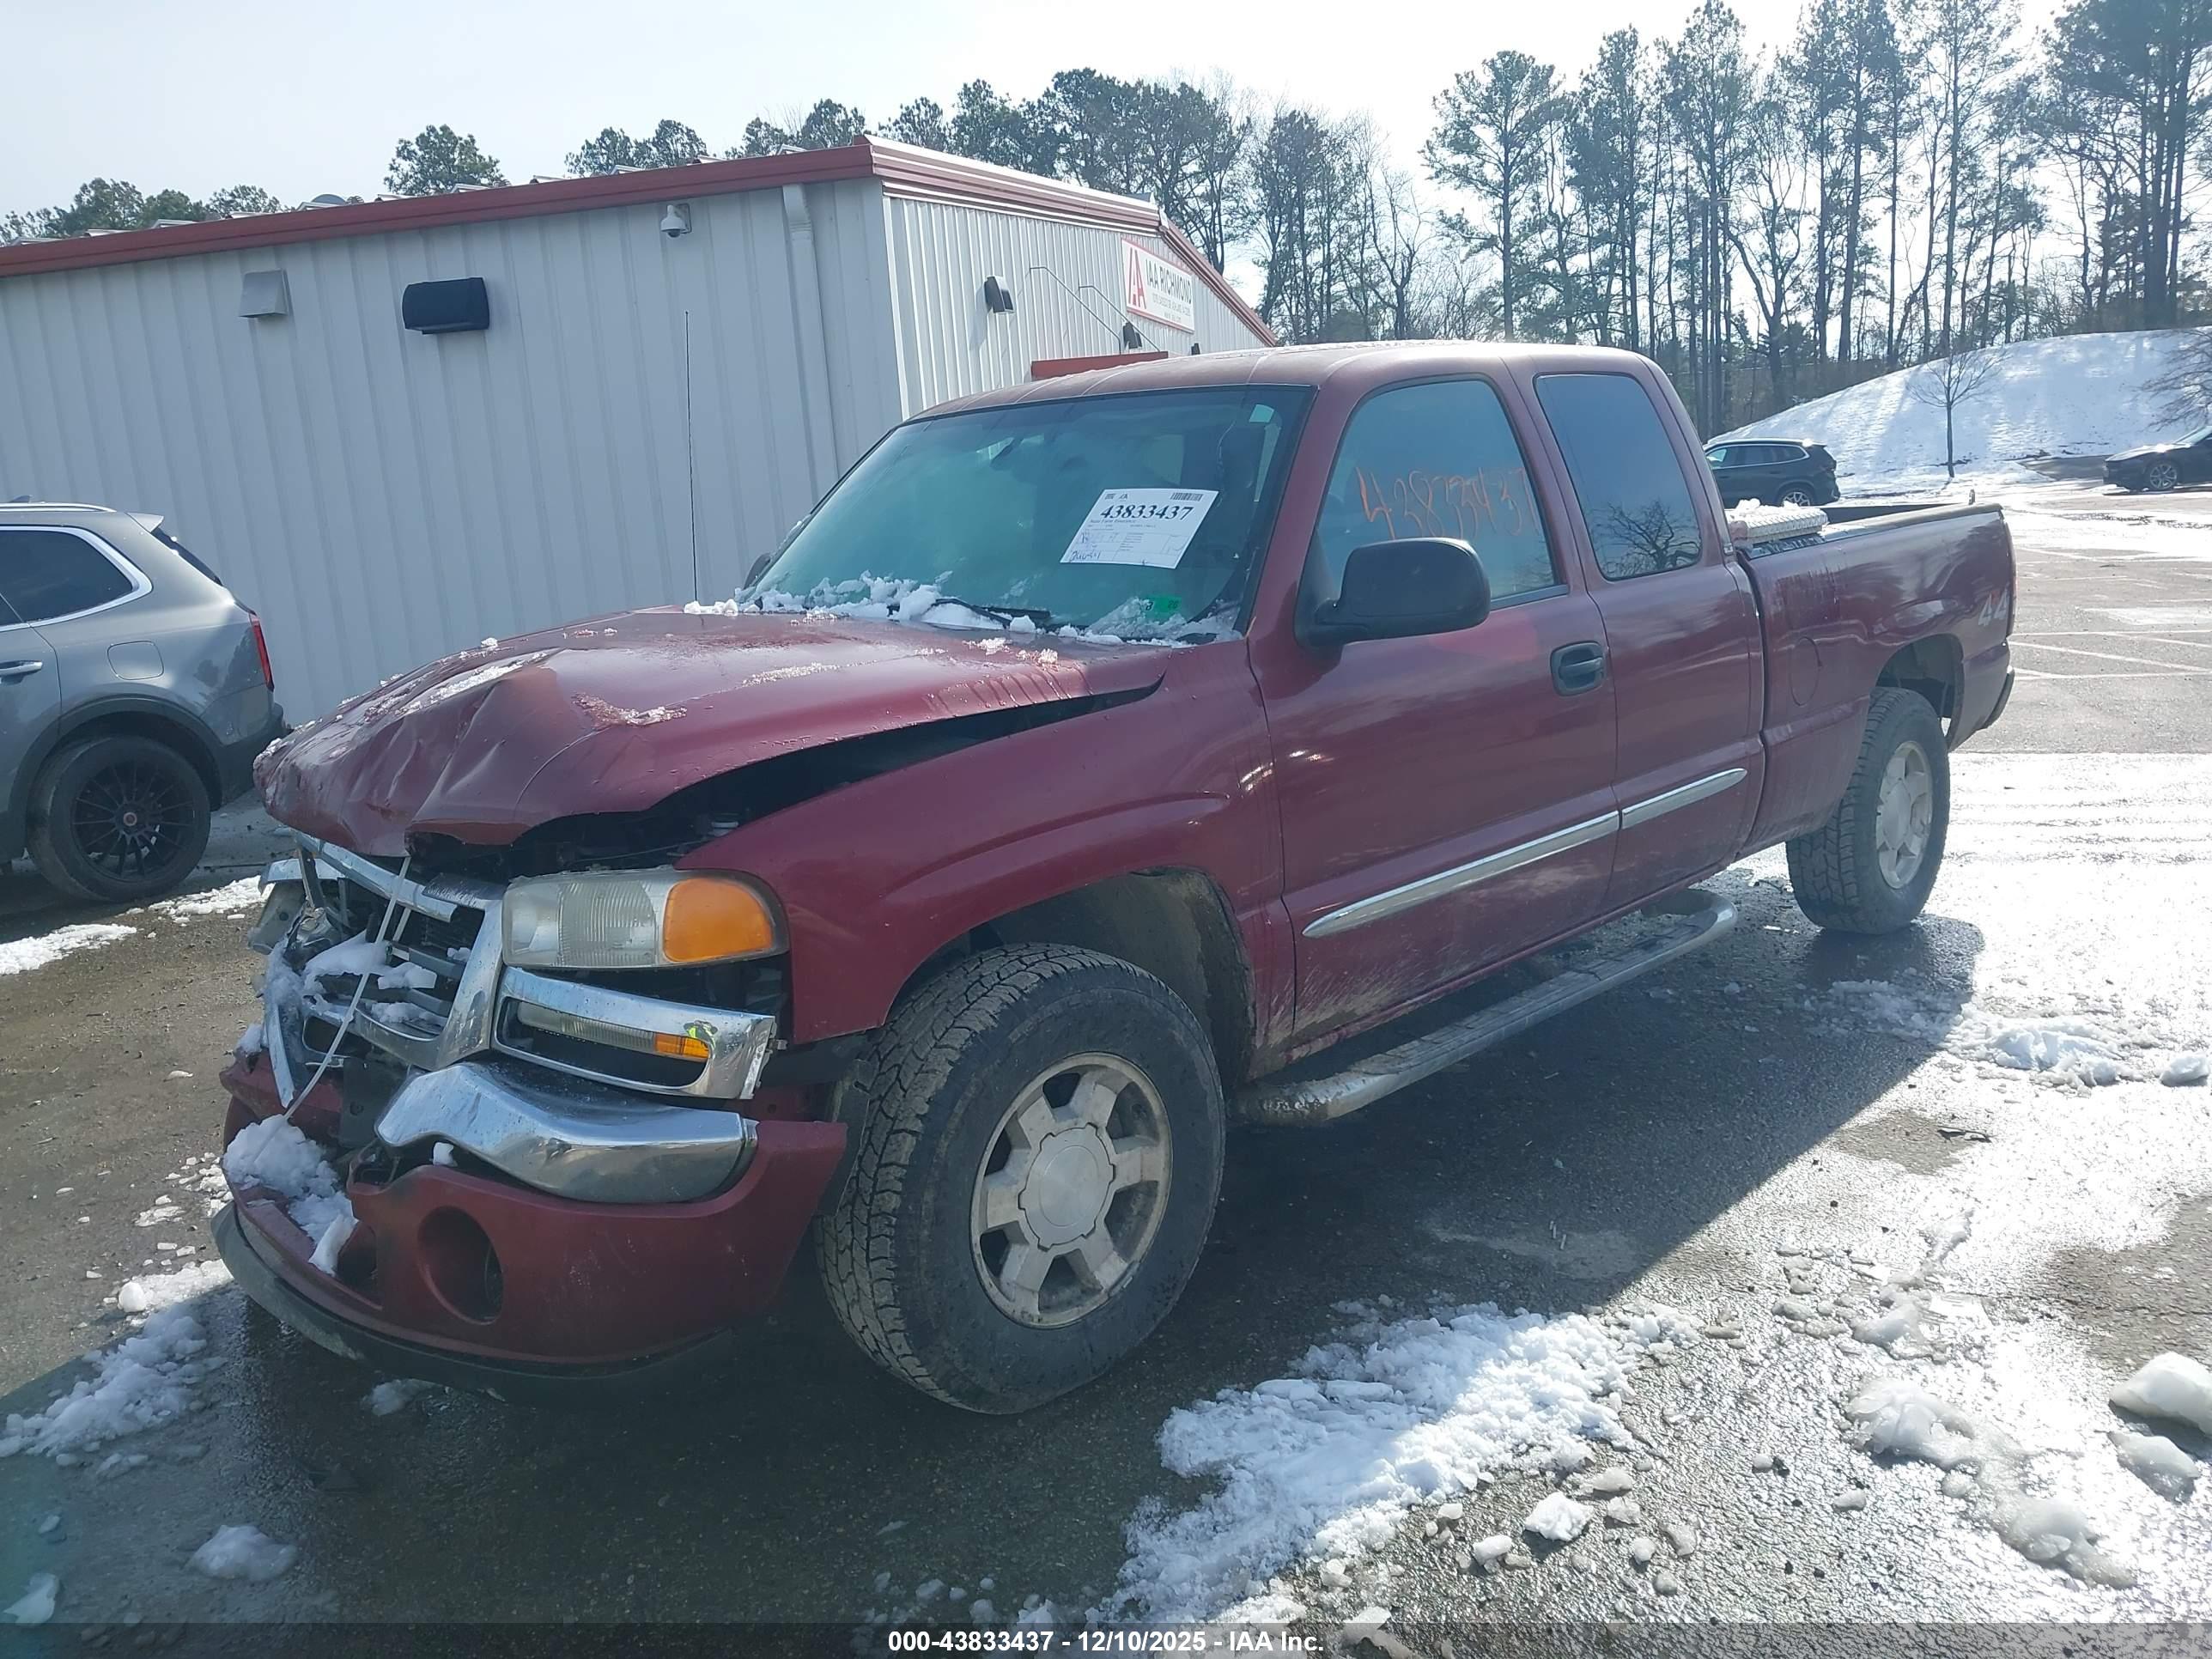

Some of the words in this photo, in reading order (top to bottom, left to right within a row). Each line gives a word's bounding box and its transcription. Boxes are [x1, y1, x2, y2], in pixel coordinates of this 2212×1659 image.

[1146, 258, 1159, 289] IAA
[1159, 266, 1192, 304] RICHMOND
[1100, 504, 1194, 520] 43833437
